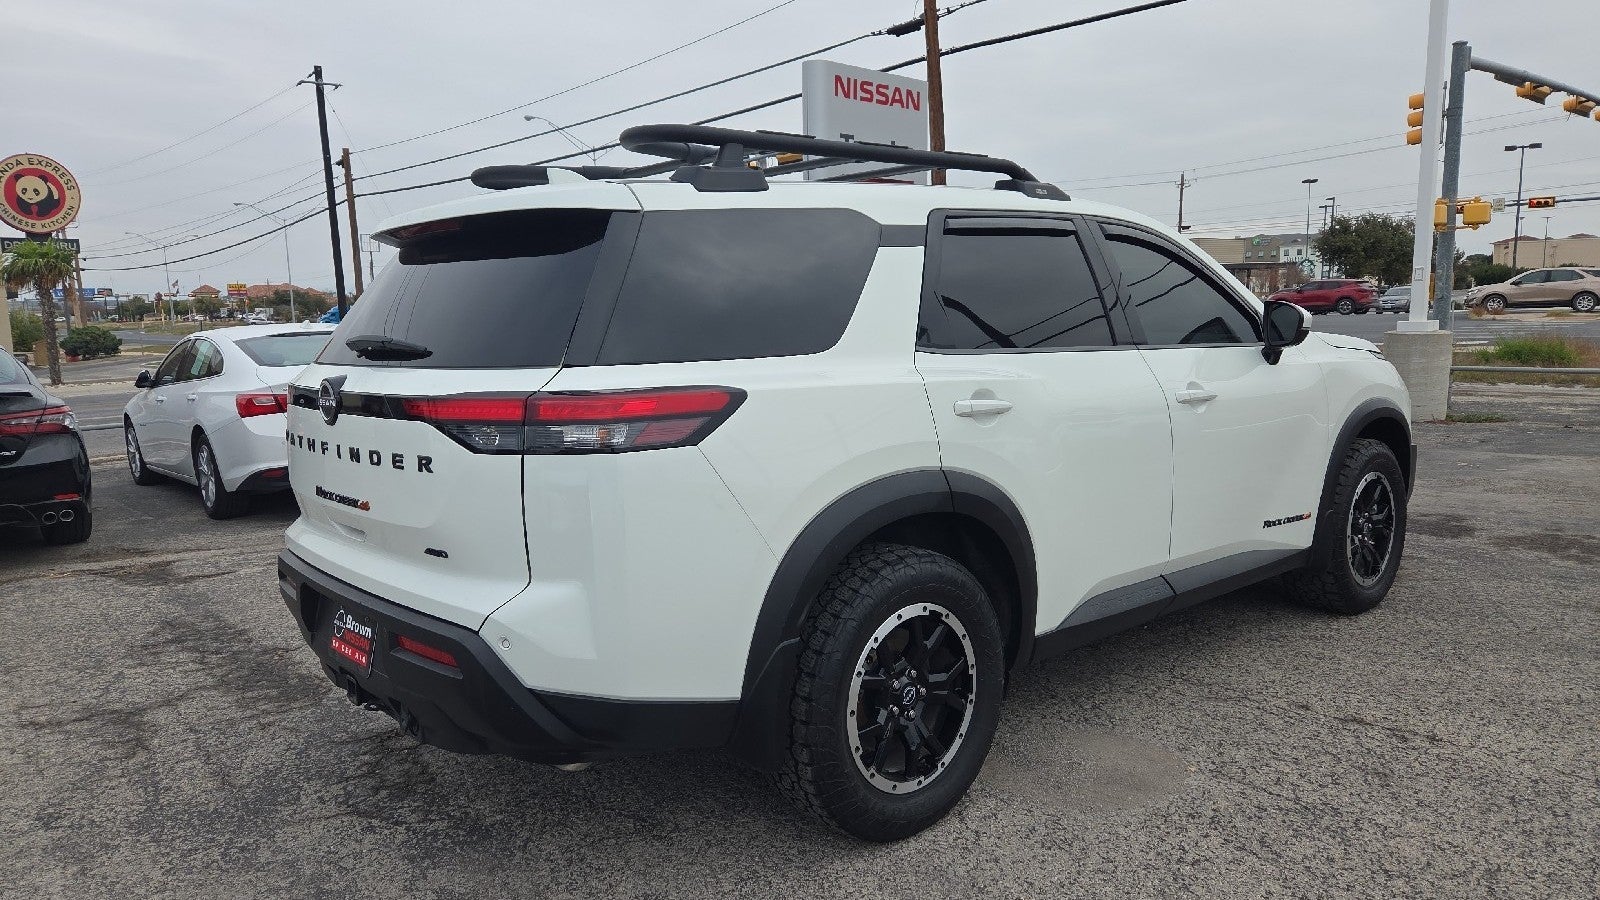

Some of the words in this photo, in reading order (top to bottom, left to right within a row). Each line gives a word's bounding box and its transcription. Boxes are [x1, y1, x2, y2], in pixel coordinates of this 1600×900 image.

[834, 74, 921, 111] NISSAN
[27, 157, 76, 191] EXPRESS
[40, 205, 76, 229] KITCHEN
[345, 614, 372, 639] Brown
[344, 629, 371, 651] NISSAN
